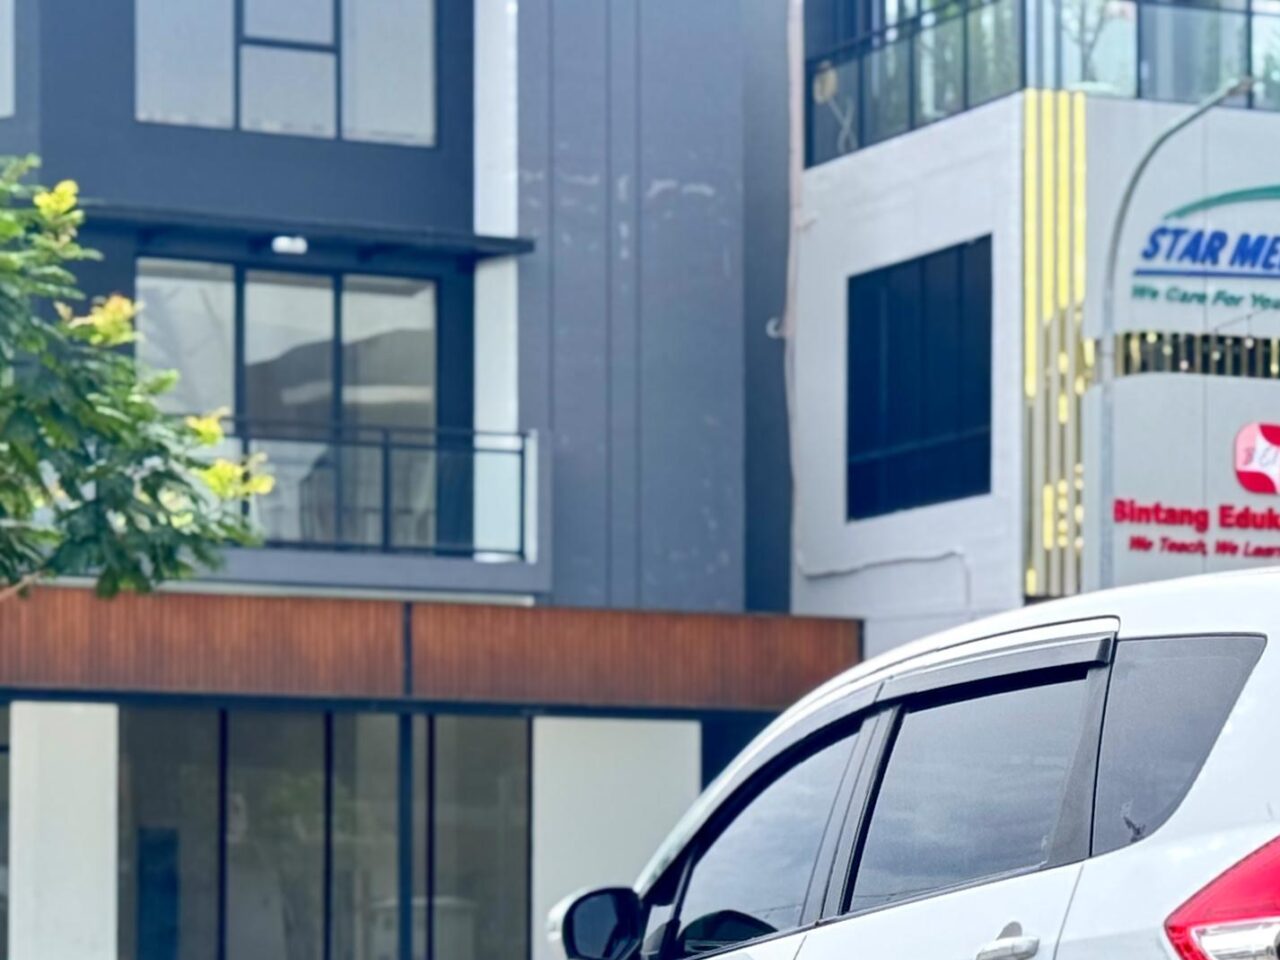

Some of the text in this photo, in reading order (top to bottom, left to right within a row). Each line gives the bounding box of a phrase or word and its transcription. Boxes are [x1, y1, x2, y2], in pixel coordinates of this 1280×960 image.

[1141, 226, 1228, 266] STAR
[1131, 284, 1158, 300] We
[1165, 287, 1207, 305] Care
[1212, 290, 1243, 307] For
[1113, 499, 1209, 533] Bintang
[1129, 536, 1154, 552] We
[1159, 537, 1207, 556] Teach,
[1215, 540, 1239, 555] We
